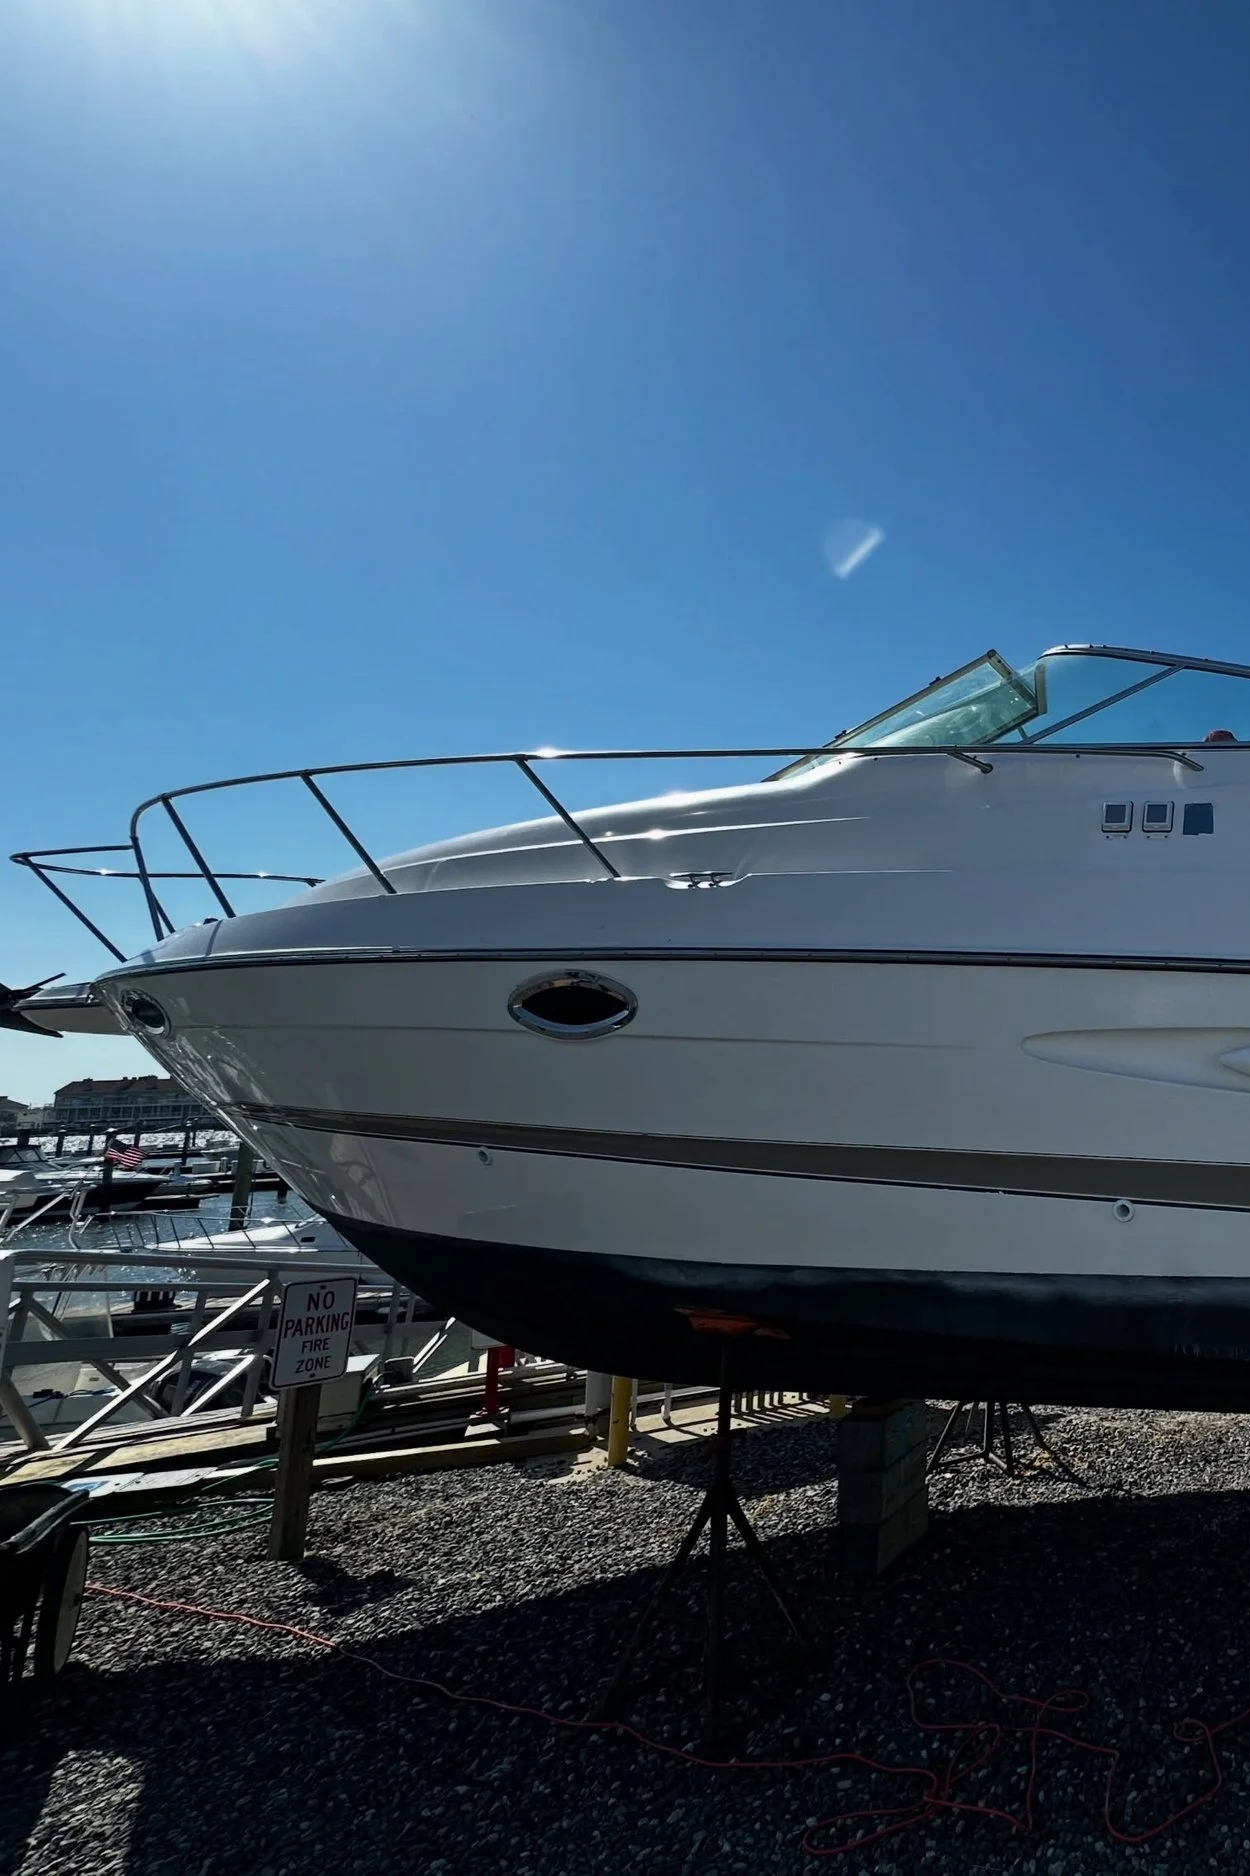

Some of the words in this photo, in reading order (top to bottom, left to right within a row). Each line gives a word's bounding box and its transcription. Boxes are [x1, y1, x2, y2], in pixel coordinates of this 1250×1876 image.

[307, 1290, 335, 1312] NO
[283, 1312, 350, 1339] PARKING
[301, 1337, 331, 1353] FIRE
[295, 1356, 332, 1374] ZONE
